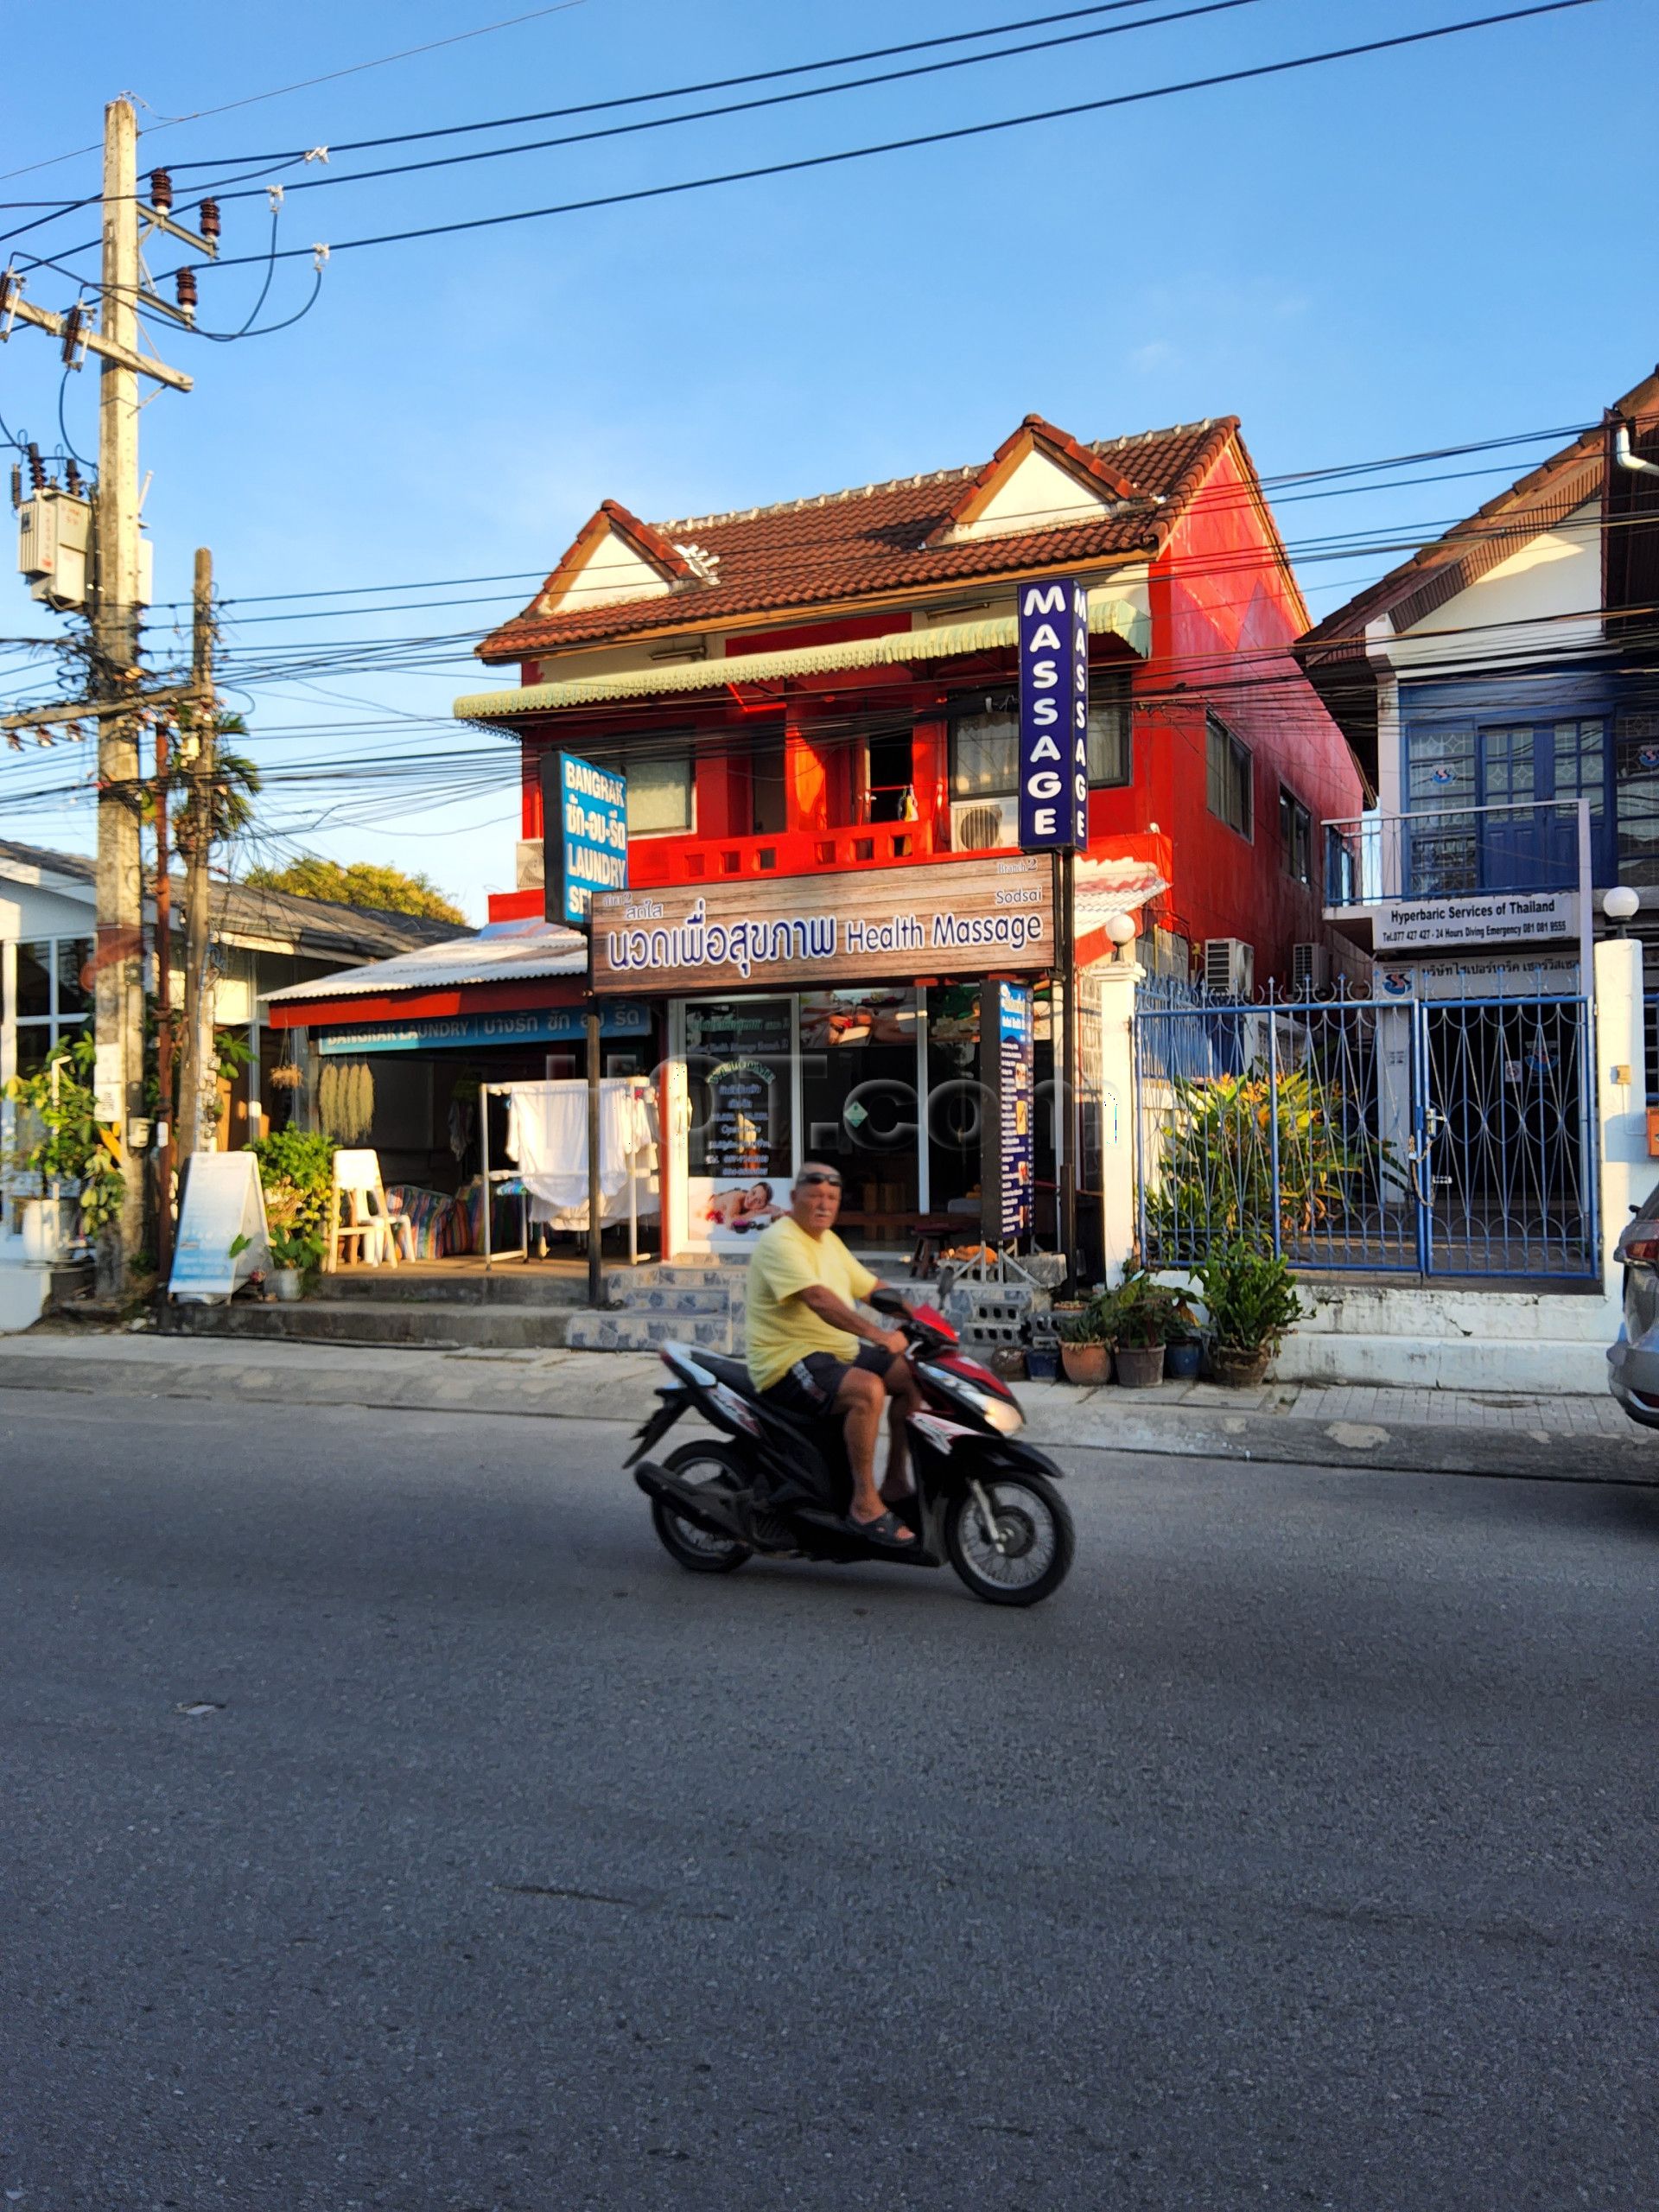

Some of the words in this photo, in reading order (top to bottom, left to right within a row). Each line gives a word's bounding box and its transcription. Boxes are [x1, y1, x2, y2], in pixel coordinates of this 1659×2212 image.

[1023, 585, 1066, 836] MASSAGE
[1074, 588, 1087, 838] MASSAGE
[564, 760, 626, 808] BANGRAK
[568, 842, 626, 890] LAUNDRY
[997, 861, 1026, 874] Branch
[1027, 858, 1037, 871] 2
[626, 899, 663, 918] สดใส
[995, 886, 1043, 905] Sodsai
[1390, 907, 1446, 925] Hyperbaric
[1448, 905, 1493, 919] Services
[1496, 902, 1506, 916] of
[1509, 899, 1555, 914] Thailand
[609, 899, 836, 977] นวดเพื่อสุขภาพ
[847, 915, 924, 952] Health
[933, 913, 1042, 950] Massage
[1435, 928, 1444, 938] 24
[1445, 927, 1464, 938] Hours
[1465, 926, 1484, 938] Diving
[1486, 925, 1522, 937] Emergency
[327, 1026, 397, 1046] BANGRAK
[399, 1020, 470, 1039] LAUNDRY
